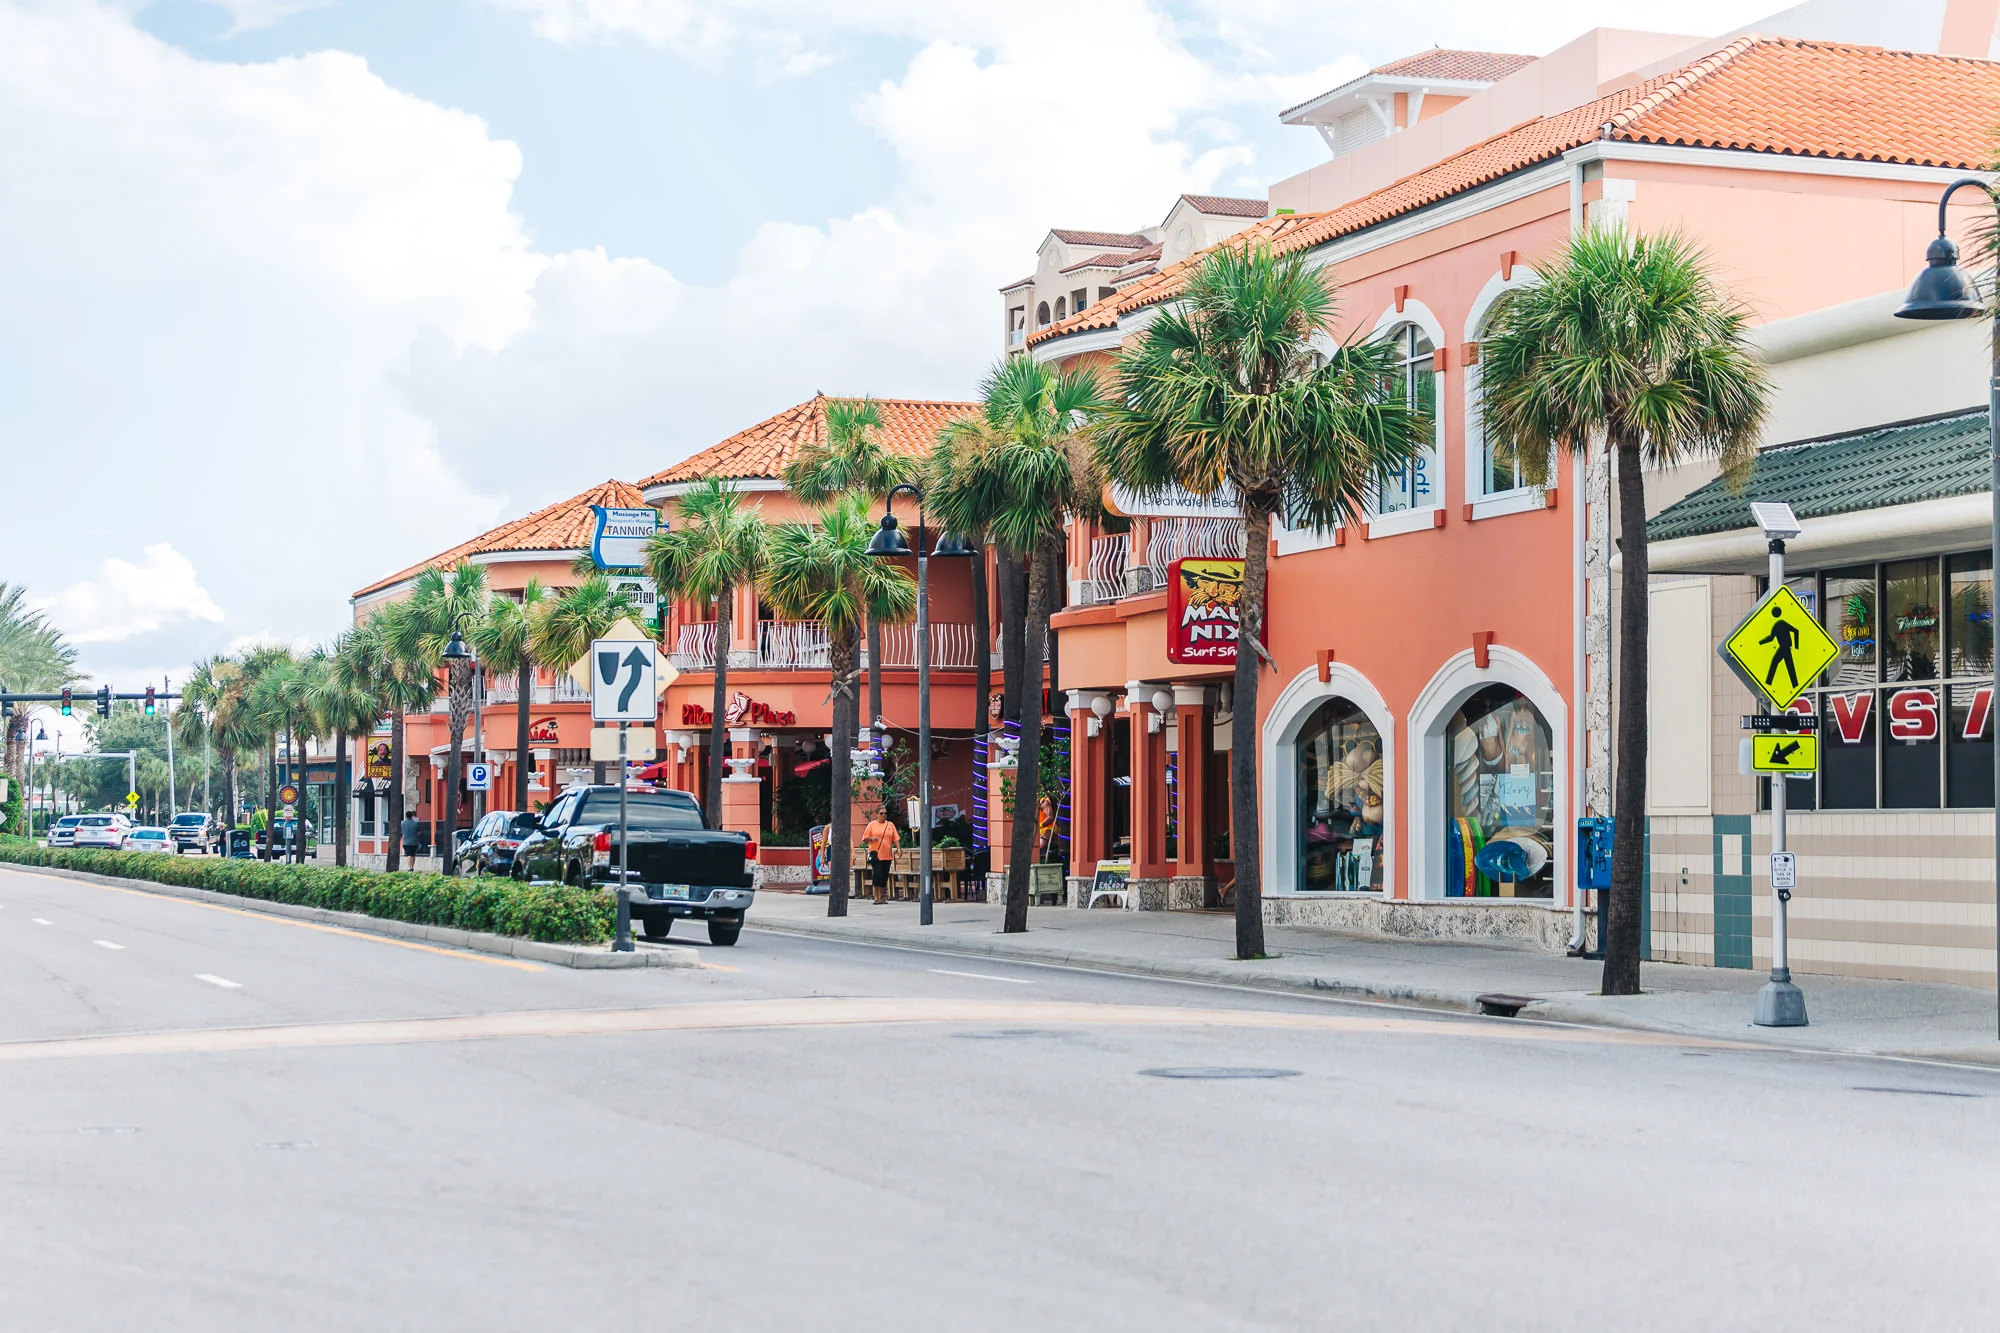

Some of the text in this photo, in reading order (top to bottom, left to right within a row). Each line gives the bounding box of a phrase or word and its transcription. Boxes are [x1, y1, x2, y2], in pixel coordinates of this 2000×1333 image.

[606, 525, 653, 536] TANNING
[1181, 605, 1240, 629] MAU
[1182, 646, 1239, 657] Surf Sh
[751, 702, 796, 726] Plaza
